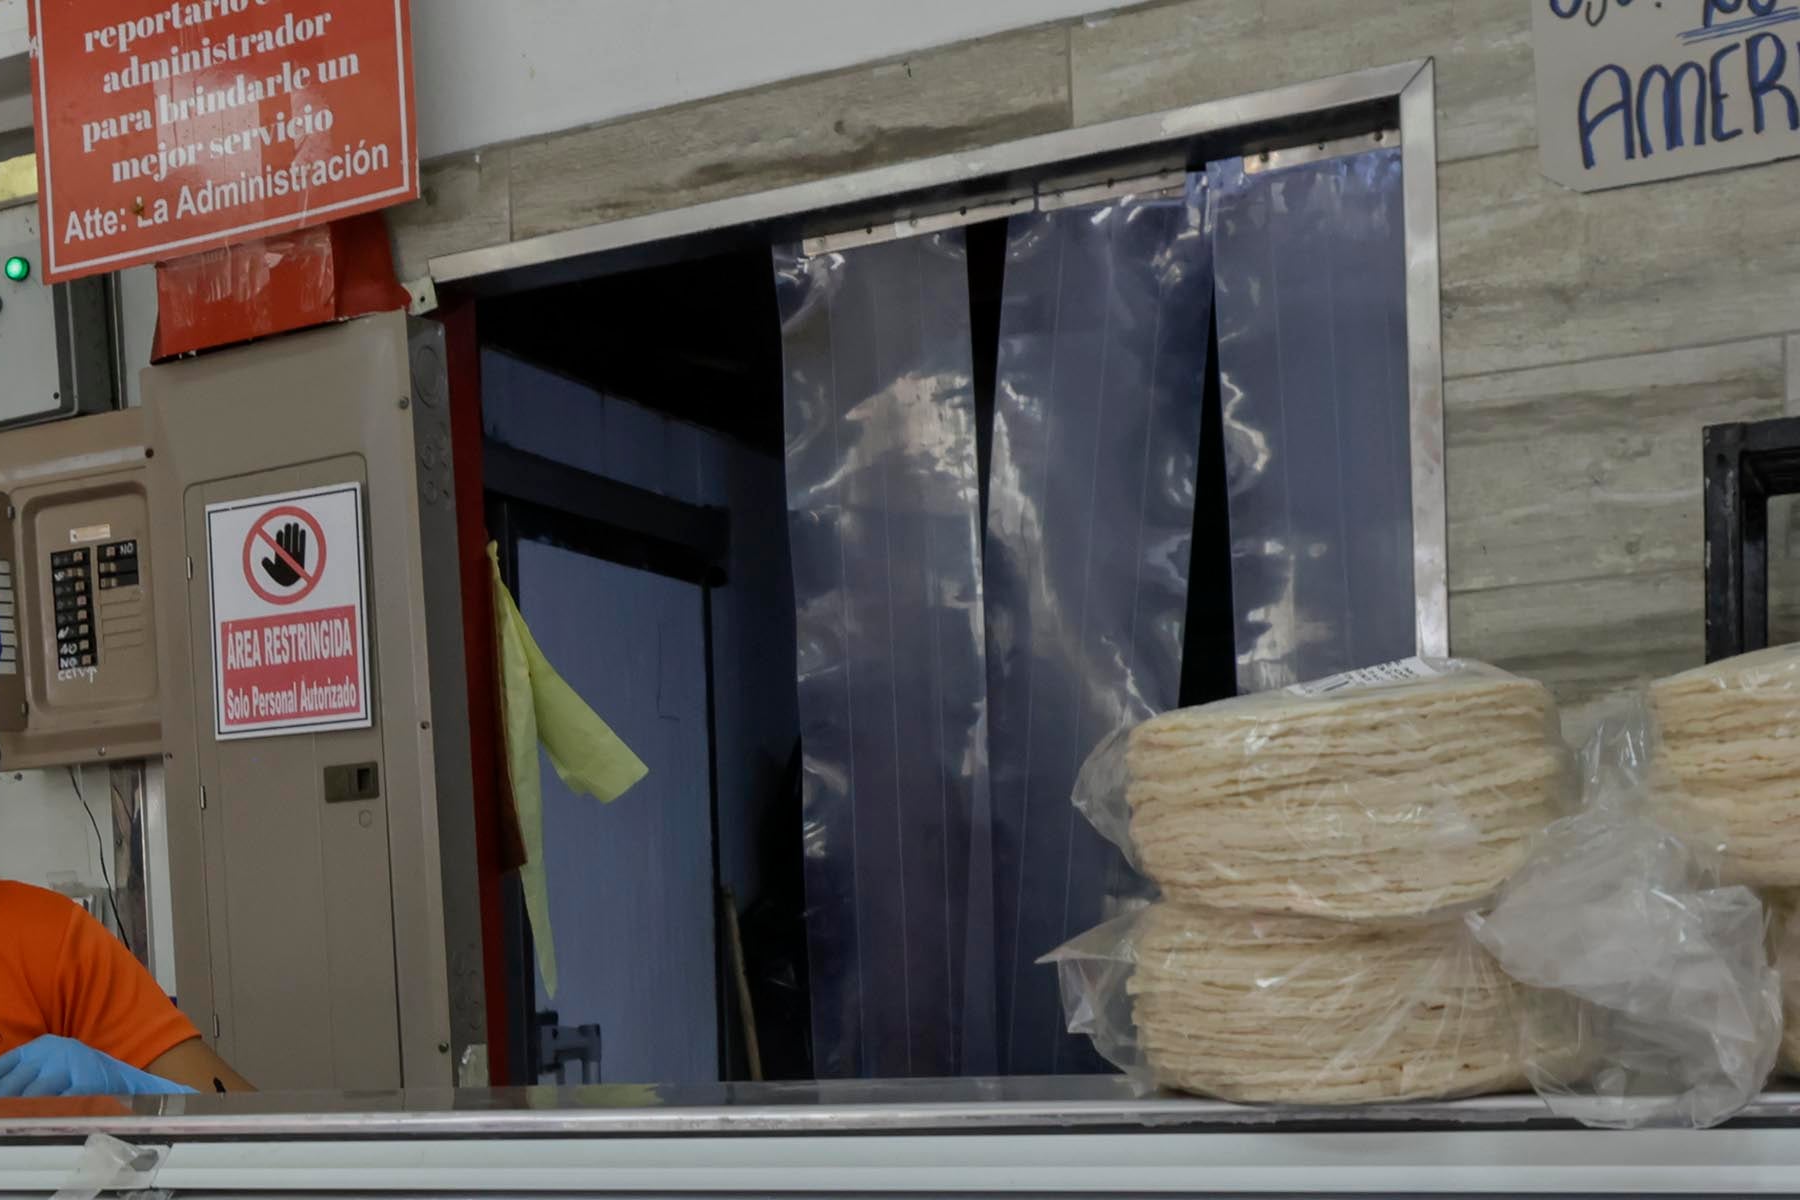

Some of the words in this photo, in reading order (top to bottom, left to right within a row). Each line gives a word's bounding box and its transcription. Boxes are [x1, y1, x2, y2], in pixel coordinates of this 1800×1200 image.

[103, 10, 332, 94] administrador
[81, 108, 153, 153] para
[156, 60, 311, 127] brindarle
[318, 53, 360, 83] un
[1578, 32, 1800, 169] AMER
[112, 140, 203, 183] mejor
[209, 104, 334, 160] servicio
[64, 209, 128, 245] Atte:
[136, 195, 169, 229] La
[176, 139, 390, 220] Administración
[227, 622, 262, 670] ÁREA
[264, 617, 353, 665] RESTRINGIDA
[227, 687, 250, 720] Solo
[251, 682, 297, 717] Personal
[300, 676, 357, 714] Autorizado
